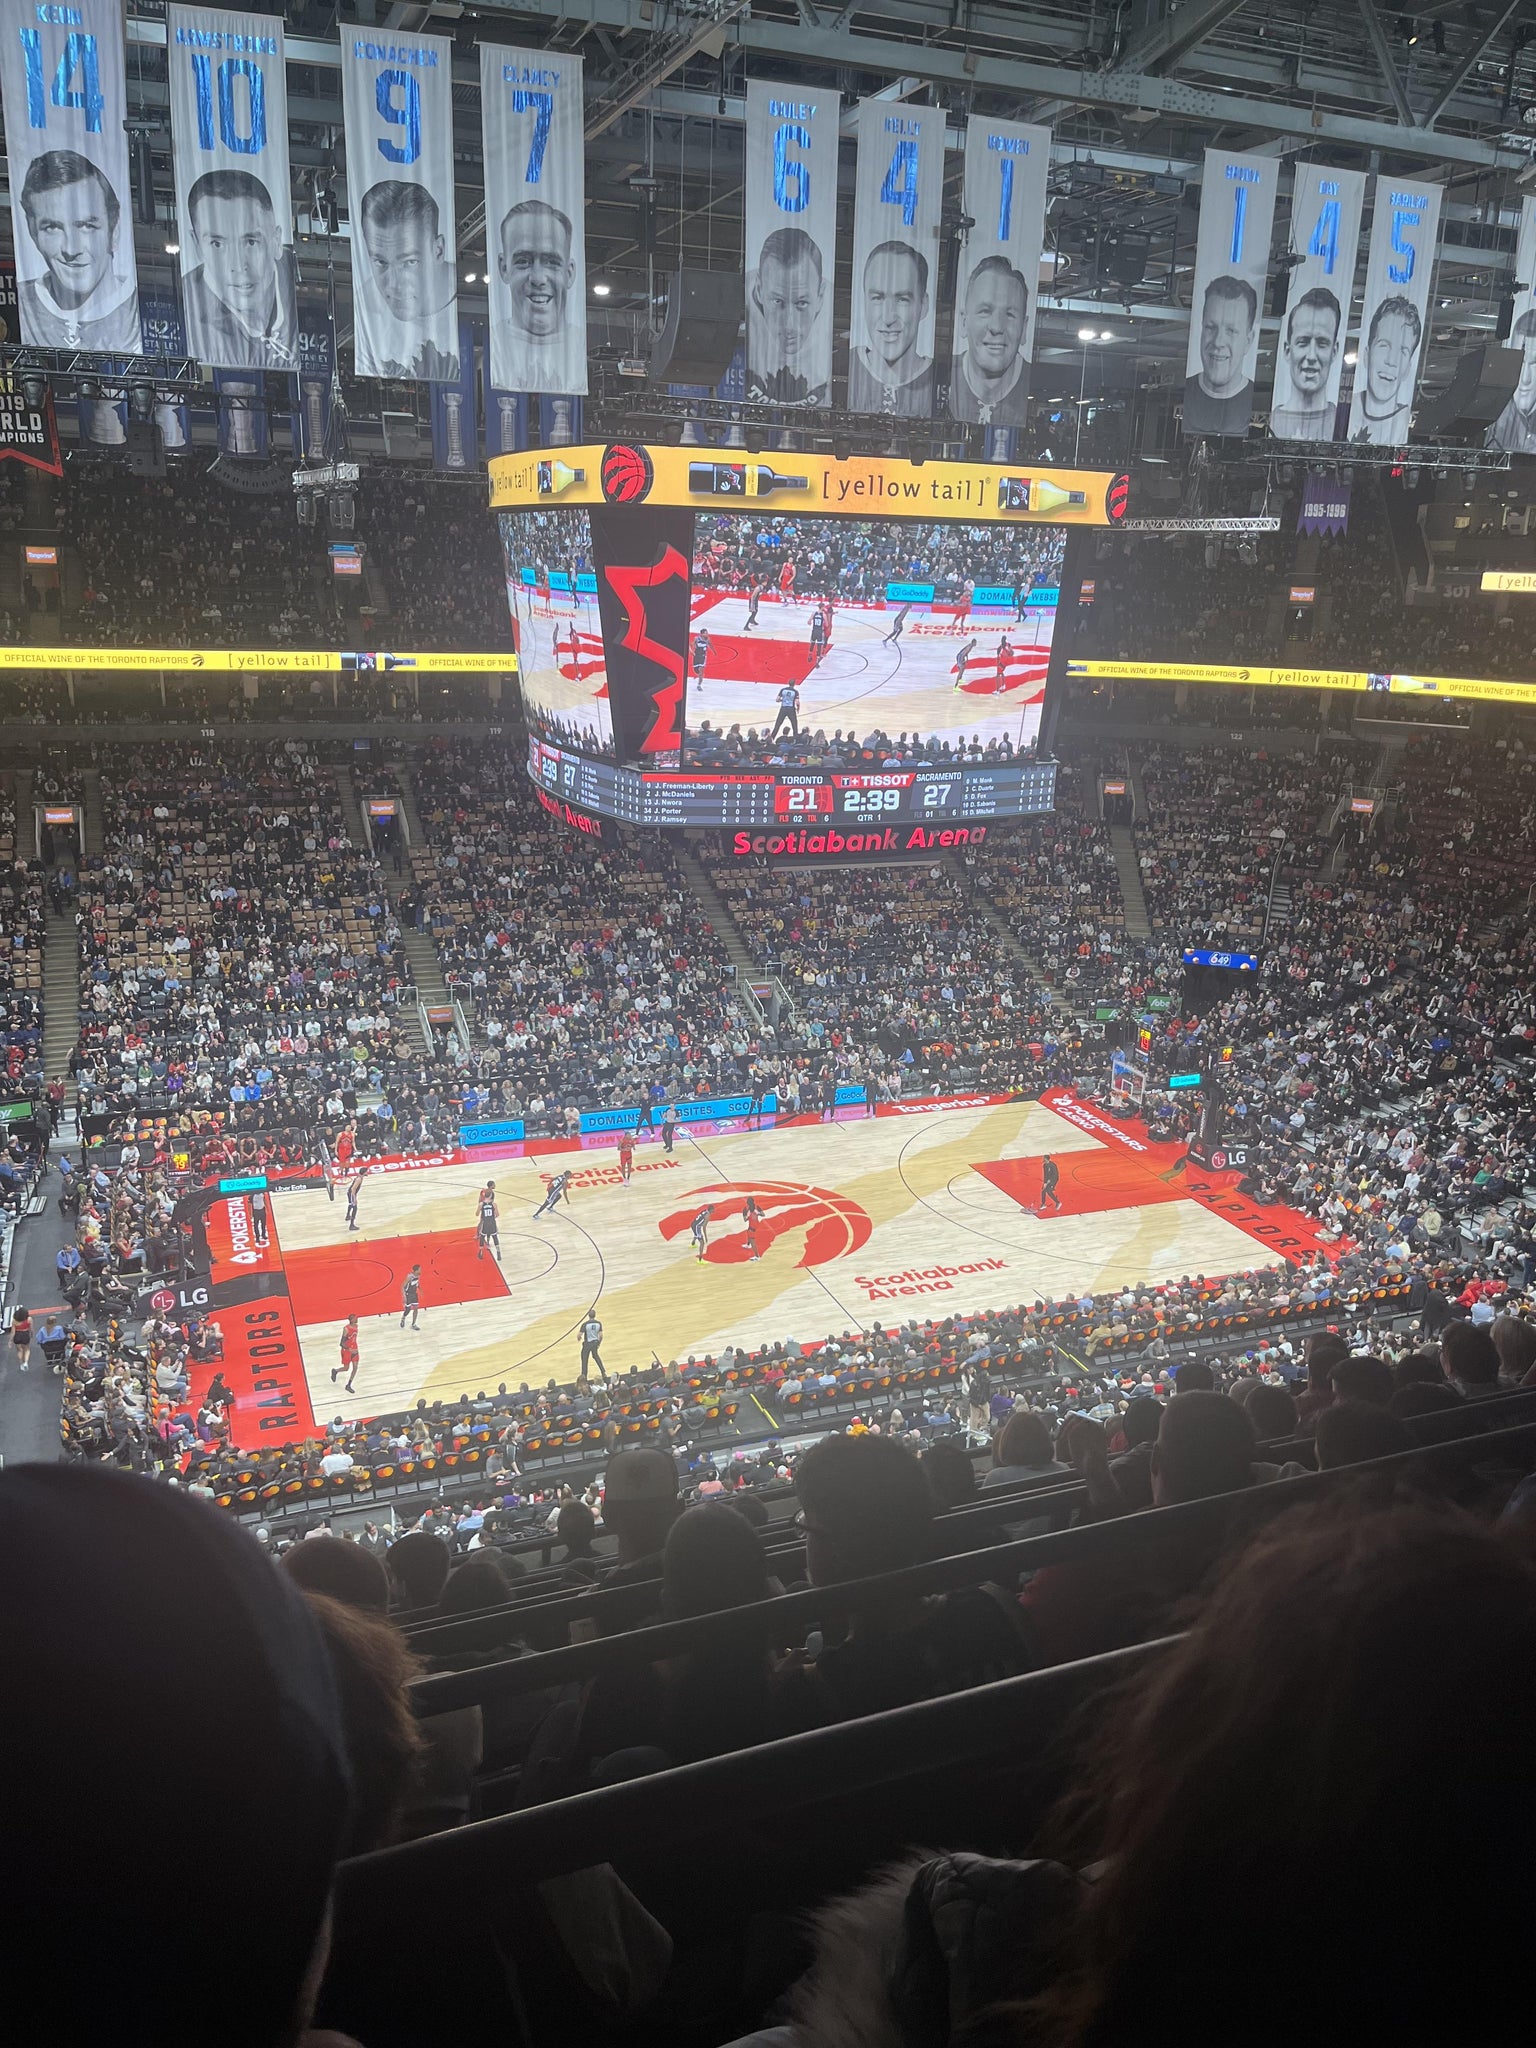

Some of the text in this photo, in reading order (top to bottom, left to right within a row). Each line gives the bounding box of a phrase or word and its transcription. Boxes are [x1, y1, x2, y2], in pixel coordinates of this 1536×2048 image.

[175, 27, 278, 56] ARMSTRONG
[354, 41, 438, 67] CONACHER
[19, 27, 104, 134] 14
[191, 54, 267, 155] 10
[376, 69, 420, 164] 9
[512, 90, 553, 183] 7
[773, 124, 810, 213] 6
[880, 141, 918, 226] 4
[998, 159, 1014, 241] 1
[1230, 187, 1248, 263] 1
[1308, 201, 1341, 274] 4
[1387, 211, 1419, 284] 5
[299, 332, 329, 353] 942
[5, 655, 189, 665] OFFICIAL WINE OF THE TORONTO RAPTORS
[429, 659, 465, 667] OFFICIAL
[466, 659, 485, 667] WINE
[1099, 666, 1130, 674] OFFICIAL
[1173, 669, 1204, 677] TORONTO
[1205, 670, 1237, 678] RAPTORS
[1449, 684, 1485, 693] OFFICIAL
[1486, 686, 1504, 694] WINE
[1504, 687, 1514, 695] OF
[1515, 688, 1530, 696] THE
[564, 764, 576, 786] 27
[781, 776, 823, 785] TORONTO
[861, 775, 910, 787] TISSOT
[916, 772, 962, 782] SACRAMENTO
[662, 783, 715, 791] Freeman-Liberty
[923, 784, 952, 806] 27
[788, 788, 818, 810] 21
[844, 789, 900, 812] 2:39
[793, 815, 802, 823] 02
[857, 814, 873, 822] QTR
[733, 827, 986, 855] Scotiabank Arena
[892, 1098, 985, 1113] Tangerine
[1056, 1107, 1095, 1129] CASINO
[1068, 1105, 1148, 1151] POKERSTARS
[480, 1127, 518, 1137] GoDaddy
[1228, 1151, 1246, 1165] LG
[539, 1159, 683, 1183] Sotiabank
[547, 1176, 625, 1189] rena
[484, 1209, 492, 1217] 10
[1184, 1182, 1316, 1260] RAPTORS
[855, 1258, 1010, 1289] Scotiabank
[180, 1288, 208, 1307] LG
[869, 1280, 955, 1301] Arena
[244, 1310, 299, 1431] RAPTORS
